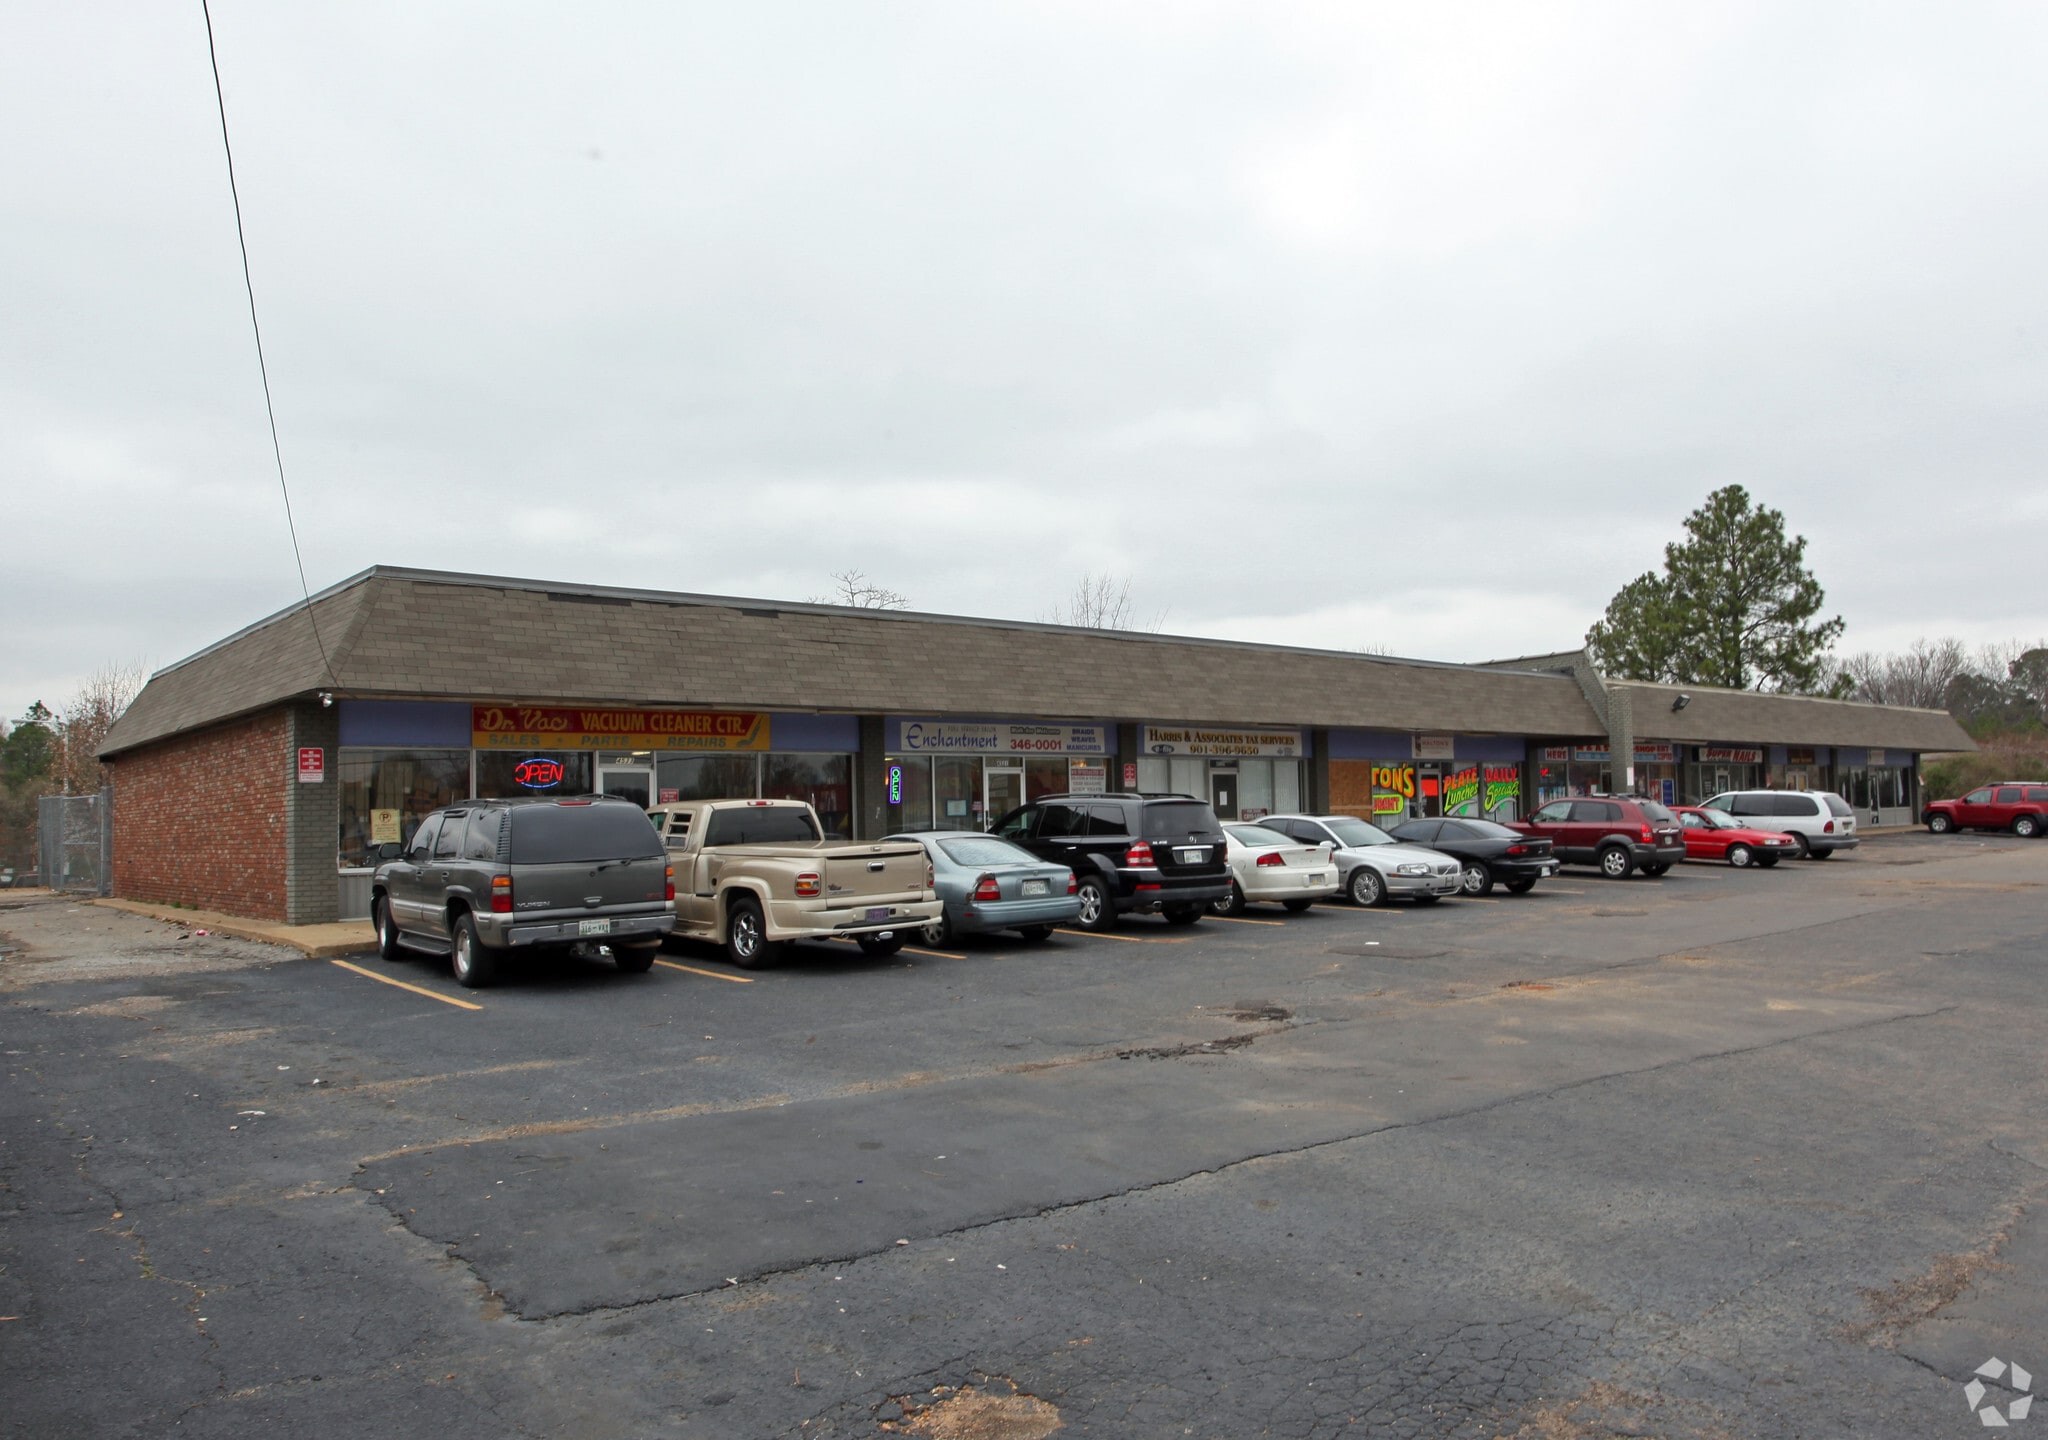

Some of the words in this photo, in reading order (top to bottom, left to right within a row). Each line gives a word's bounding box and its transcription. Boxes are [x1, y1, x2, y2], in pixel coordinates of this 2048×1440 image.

[482, 708, 516, 731] Dr.
[520, 709, 568, 731] Vac
[581, 712, 645, 732] VACUUM
[650, 713, 712, 733] CLEANER
[716, 715, 746, 734] CTR.
[488, 733, 540, 746] SALES
[581, 735, 630, 747] PARTS
[667, 736, 727, 748] REPAIRS
[906, 723, 998, 749] Enchantment
[1010, 738, 1062, 750] 346-0001
[1150, 728, 1183, 742] HARRIS
[1184, 730, 1191, 742] &
[1194, 731, 1243, 744] ASSOCIATES
[1245, 736, 1259, 744] TAX
[1260, 736, 1295, 745] SERVICES
[1733, 749, 1757, 762] NAILS
[515, 763, 565, 783] OPEN
[1443, 767, 1478, 793] PLATE
[1485, 768, 1519, 784] DAILY
[892, 769, 900, 801] OPEN
[1484, 779, 1521, 813] Specials
[1444, 783, 1479, 814] Lunches
